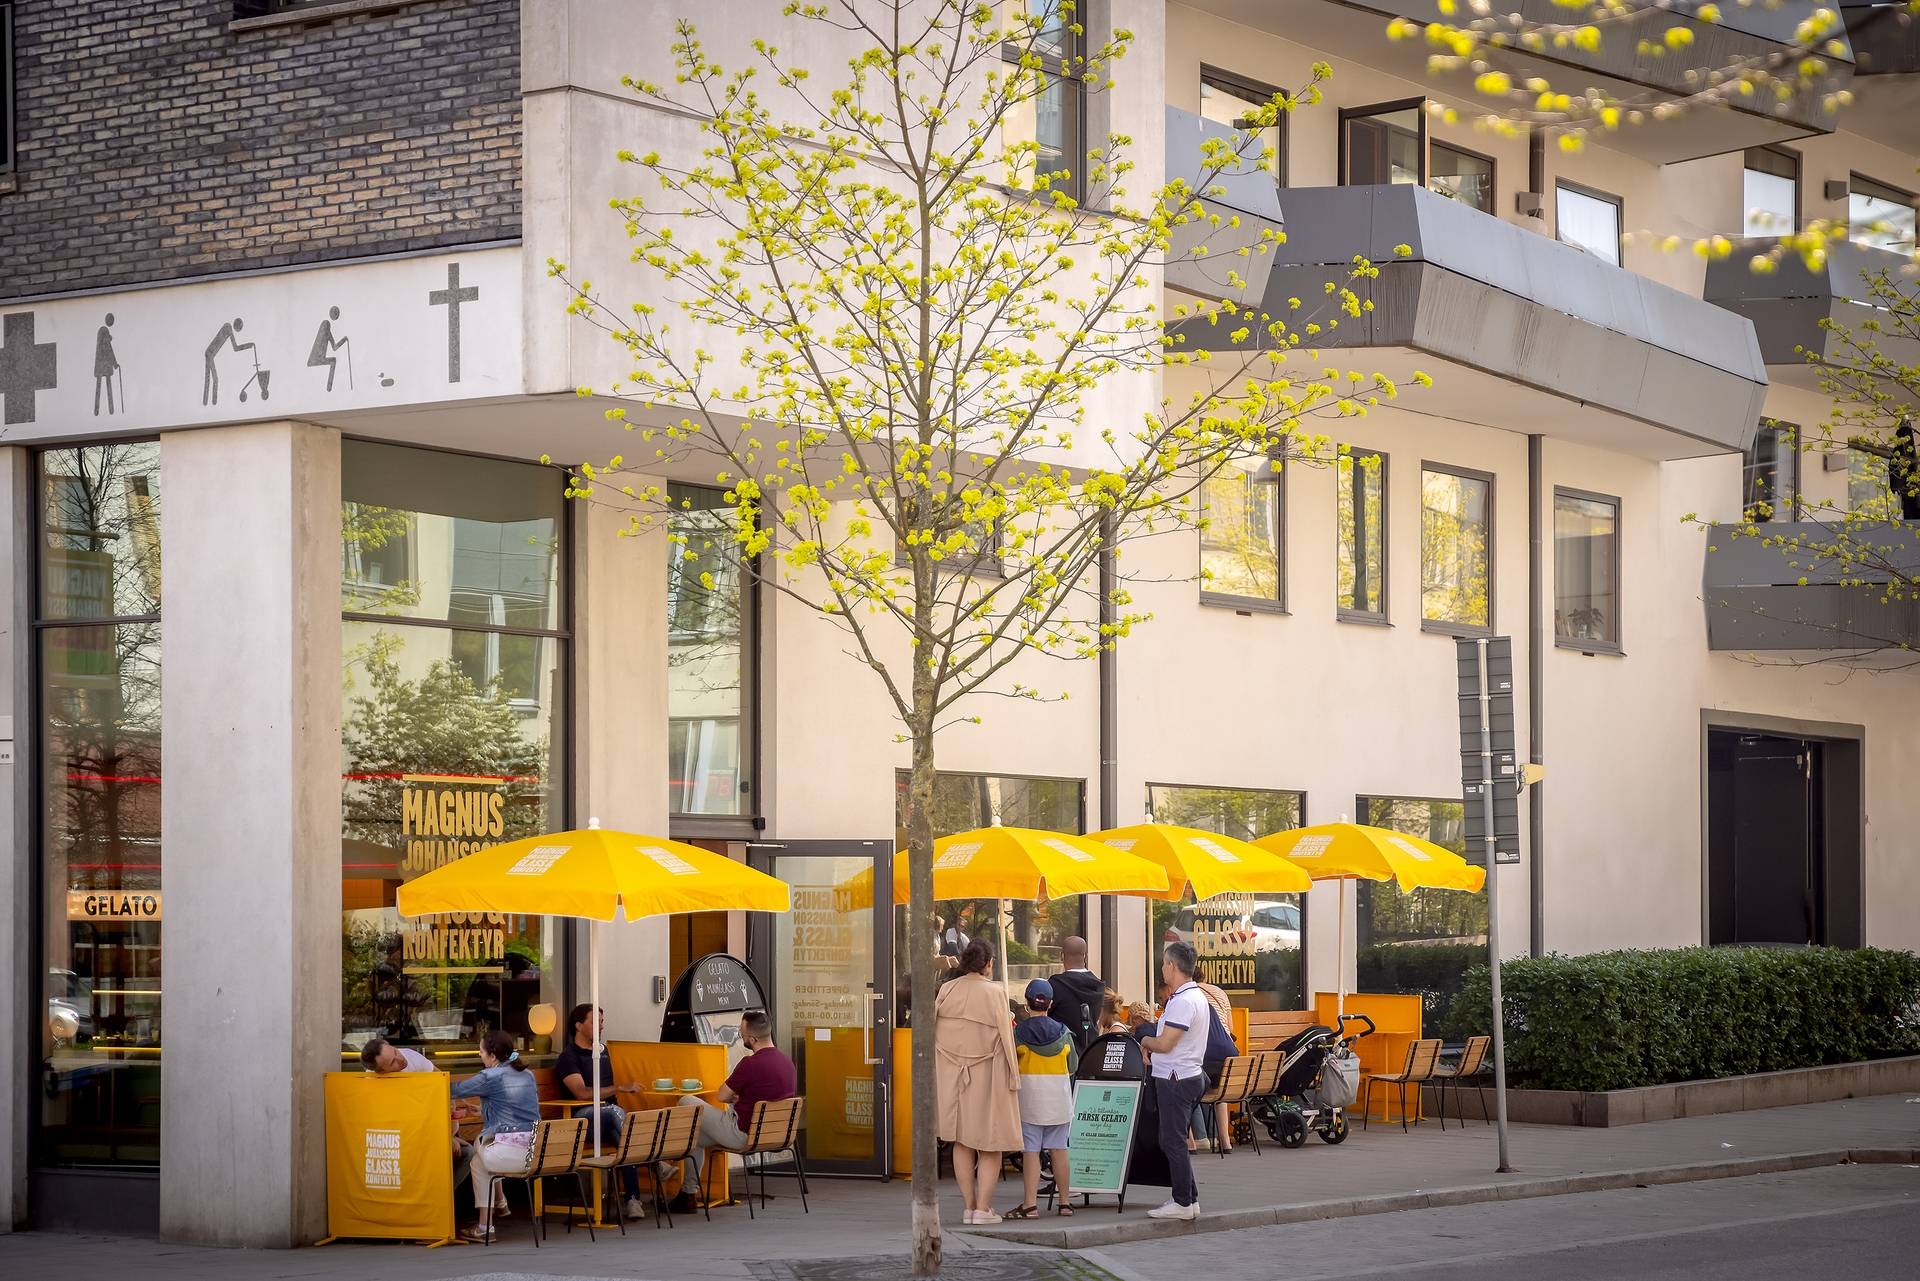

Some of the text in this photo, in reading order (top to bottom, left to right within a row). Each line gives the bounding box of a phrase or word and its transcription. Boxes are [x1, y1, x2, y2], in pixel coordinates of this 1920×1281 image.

[402, 789, 504, 838] MAGNUS
[402, 840, 504, 871] JOHANS
[84, 895, 157, 916] GELATO
[403, 928, 505, 960] KONFEKTYR
[1194, 920, 1242, 956] GLASS
[1101, 1113, 1128, 1123] GELATO
[366, 1133, 400, 1149] MAGNUS
[366, 1158, 392, 1175] GLASS
